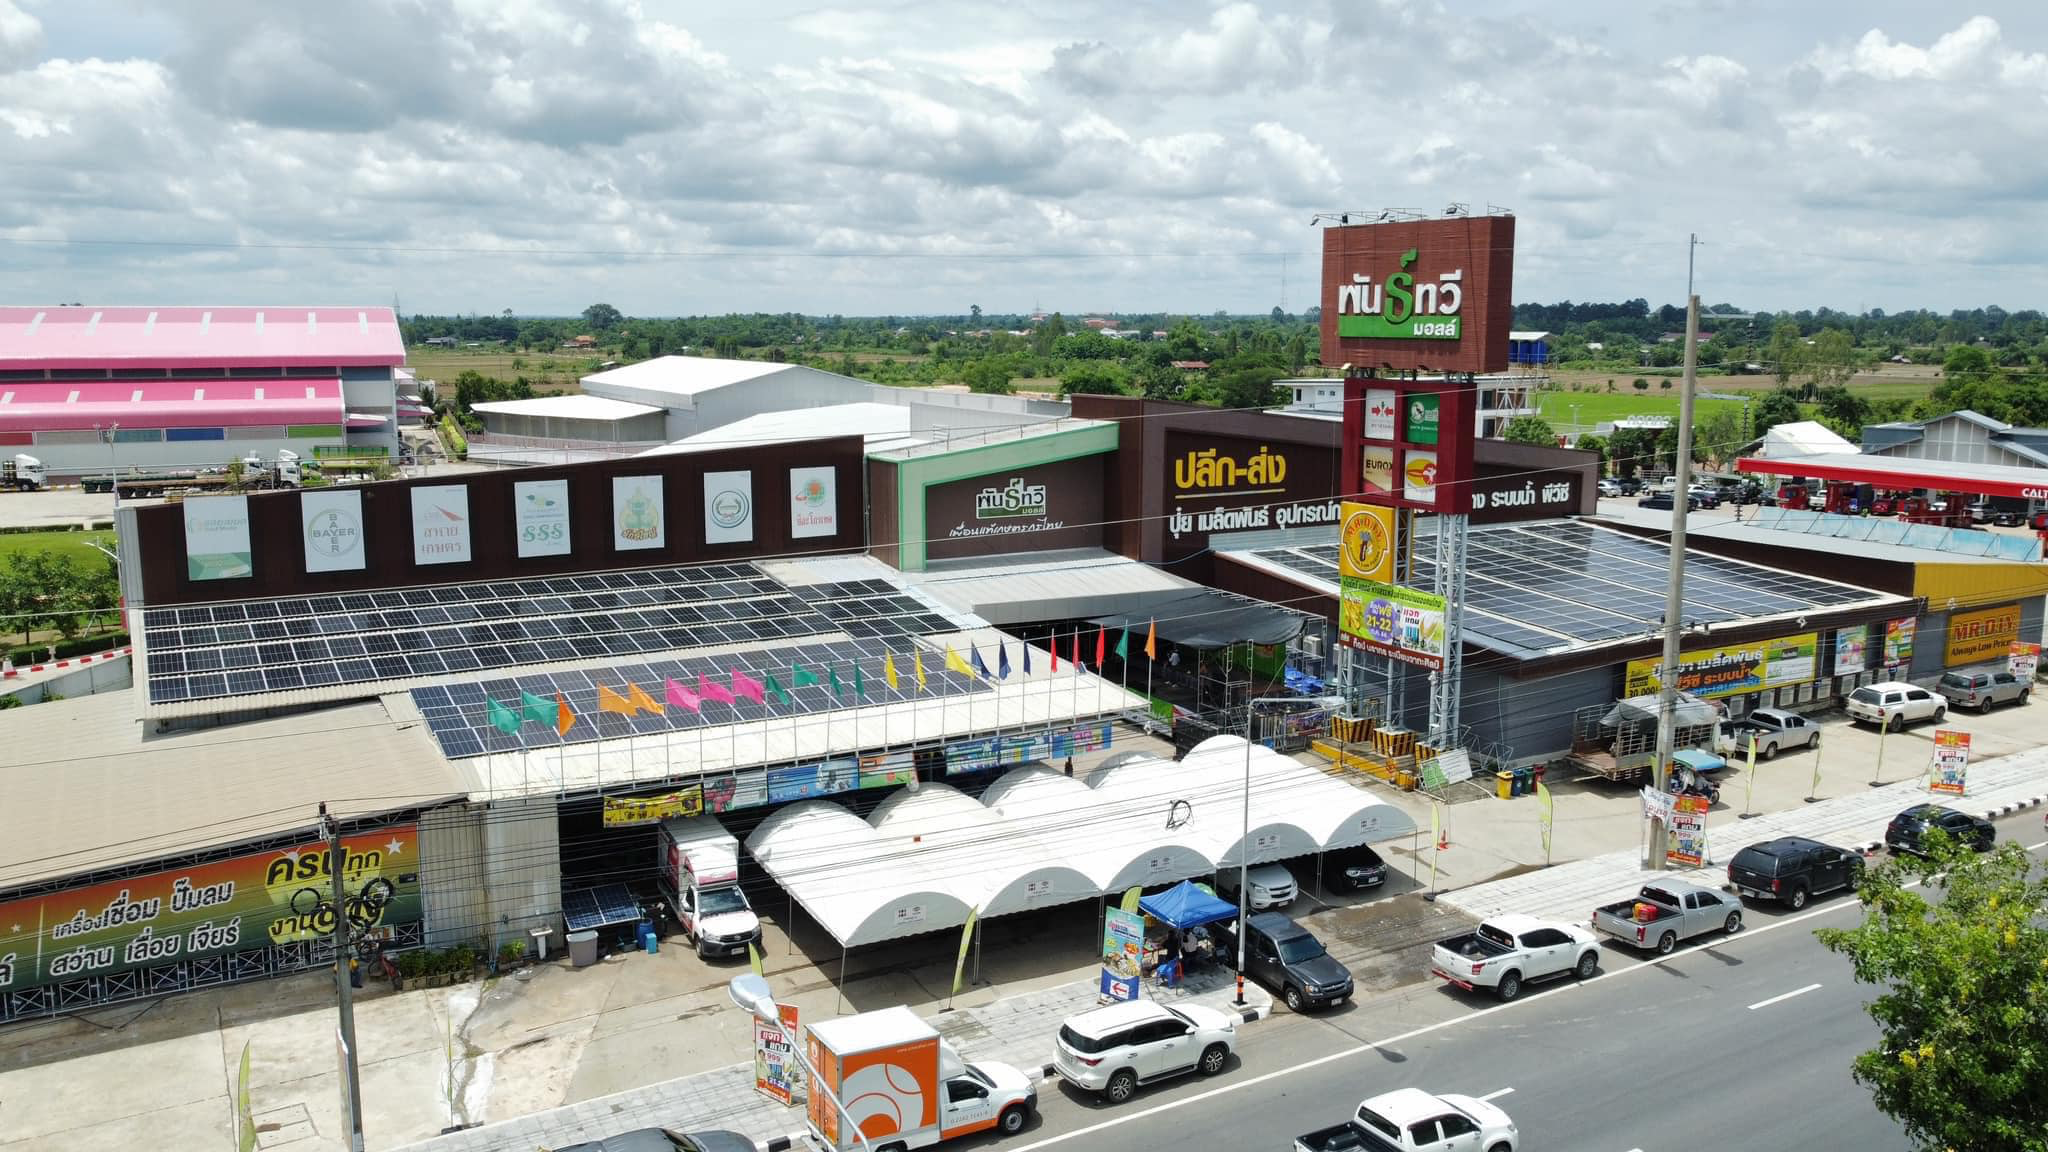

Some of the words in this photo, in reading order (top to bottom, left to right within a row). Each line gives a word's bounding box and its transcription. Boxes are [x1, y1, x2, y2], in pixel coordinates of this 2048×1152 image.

[1413, 319, 1457, 336] มอลล์
[1175, 446, 1286, 488] ปลีก-ส่ง
[312, 527, 356, 539] BAYER
[53, 889, 160, 939] เครื่องเชื่อม
[170, 877, 234, 913] ปั๊มลม
[50, 945, 114, 976] สว่าน
[124, 927, 181, 963] เลื่อย
[187, 917, 241, 953] เจียร์
